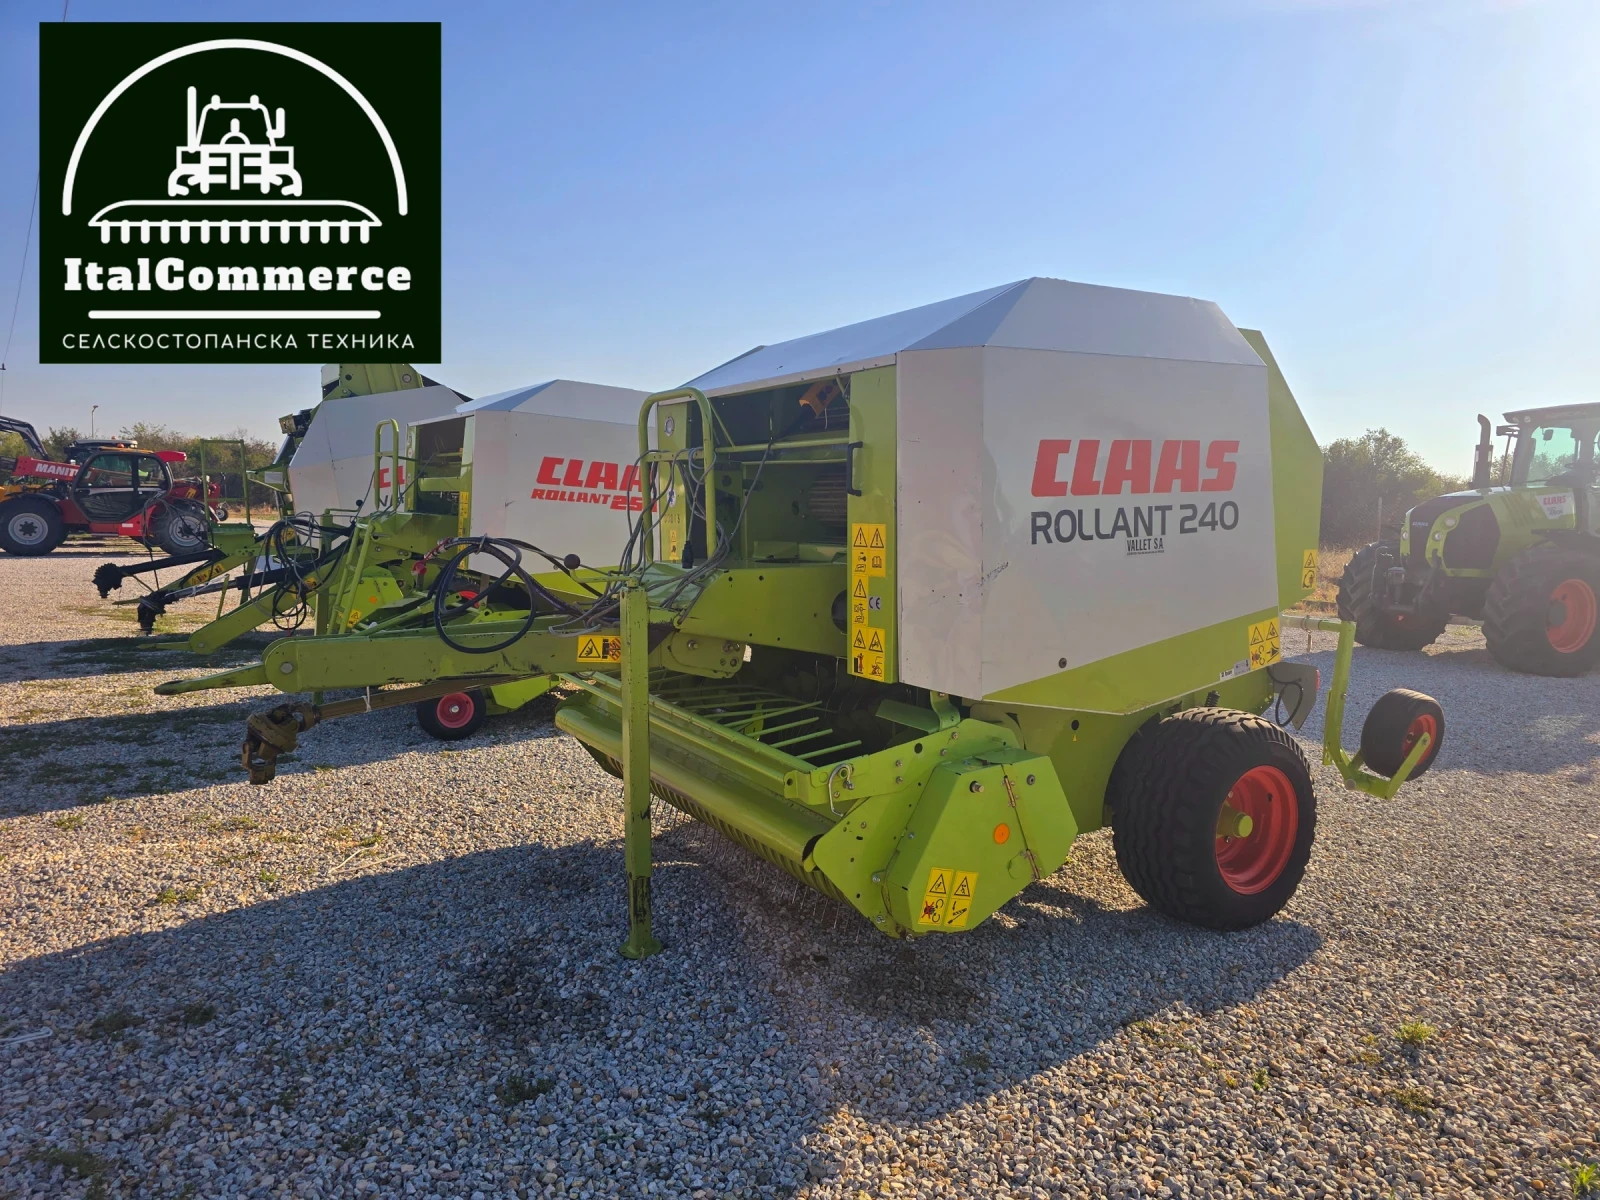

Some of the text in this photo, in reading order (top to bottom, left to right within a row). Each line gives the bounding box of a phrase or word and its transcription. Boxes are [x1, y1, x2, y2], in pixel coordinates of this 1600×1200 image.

[536, 456, 653, 493] CLAA
[1031, 439, 1240, 497] CLAAS
[530, 488, 657, 512] ROLLANT 25
[1030, 501, 1239, 545] ROLLANT 240
[1126, 537, 1164, 551] VALLET SA
